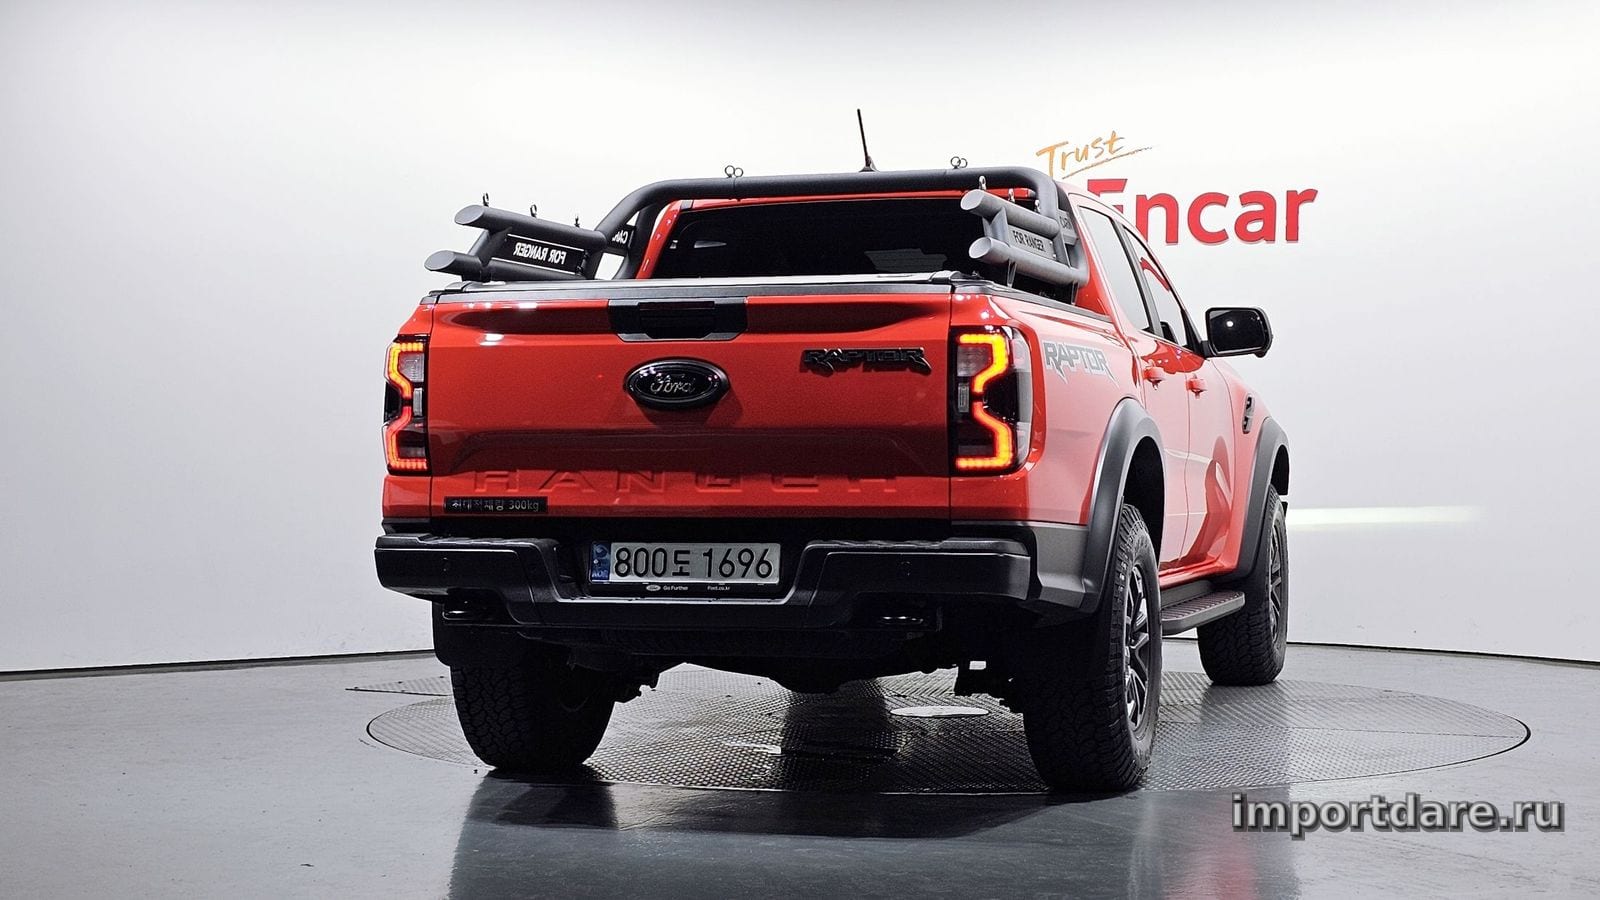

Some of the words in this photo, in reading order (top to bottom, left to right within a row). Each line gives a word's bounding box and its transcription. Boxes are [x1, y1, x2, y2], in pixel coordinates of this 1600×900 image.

[1035, 130, 1125, 179] Trust
[1012, 230, 1027, 246] FOR
[1024, 233, 1046, 252] RANGER
[803, 347, 932, 374] RAPTOR
[1042, 340, 1118, 386] RAPTOR
[650, 373, 697, 394] Ford
[508, 499, 539, 512] 300kg
[614, 547, 691, 578] 800도
[702, 548, 773, 579] 1696
